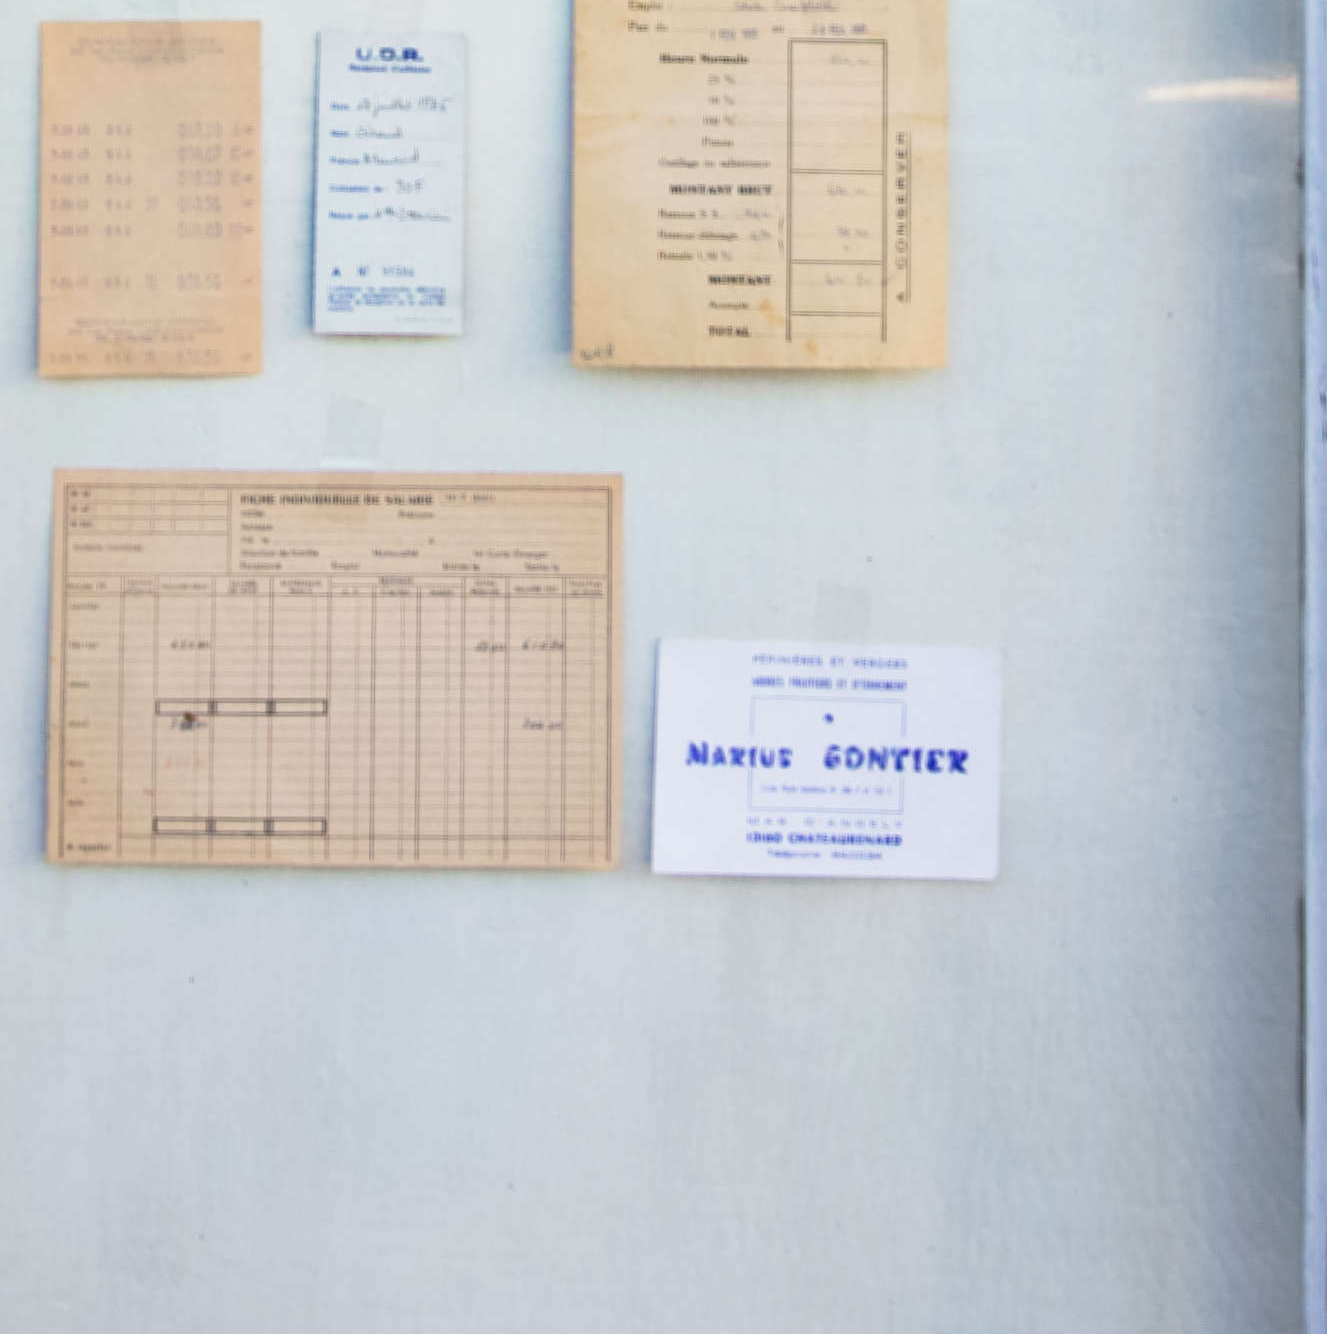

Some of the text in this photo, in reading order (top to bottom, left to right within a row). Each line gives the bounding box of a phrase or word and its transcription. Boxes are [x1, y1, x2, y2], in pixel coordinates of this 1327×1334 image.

[669, 184, 733, 196] MONTANT
[708, 274, 772, 286] MONTANT
[685, 740, 970, 775] MARIUS GONTIER
